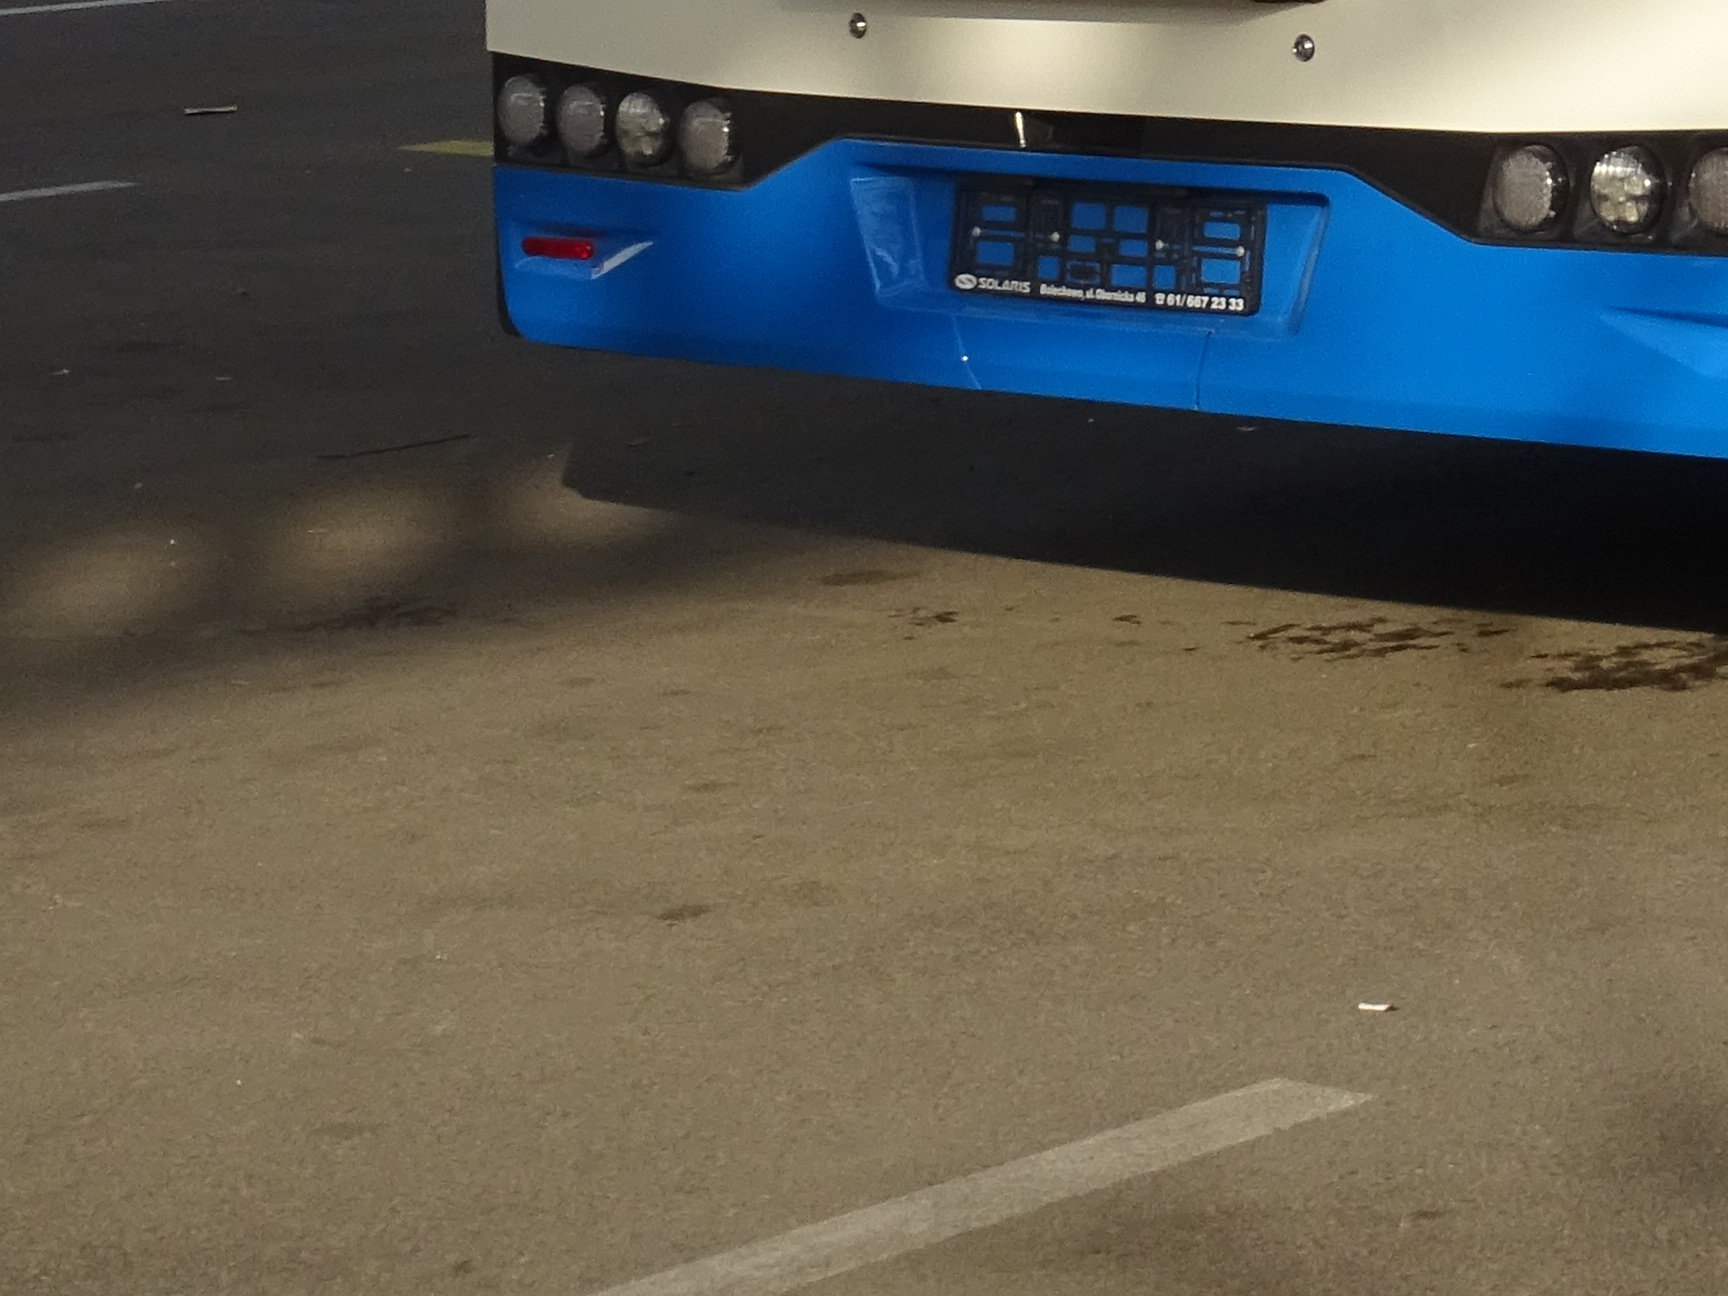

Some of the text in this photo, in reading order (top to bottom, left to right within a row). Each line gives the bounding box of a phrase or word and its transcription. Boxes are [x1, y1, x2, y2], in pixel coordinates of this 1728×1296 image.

[978, 277, 1031, 294] SOLARIS
[1210, 296, 1227, 311] 23
[1228, 297, 1245, 312] 33
